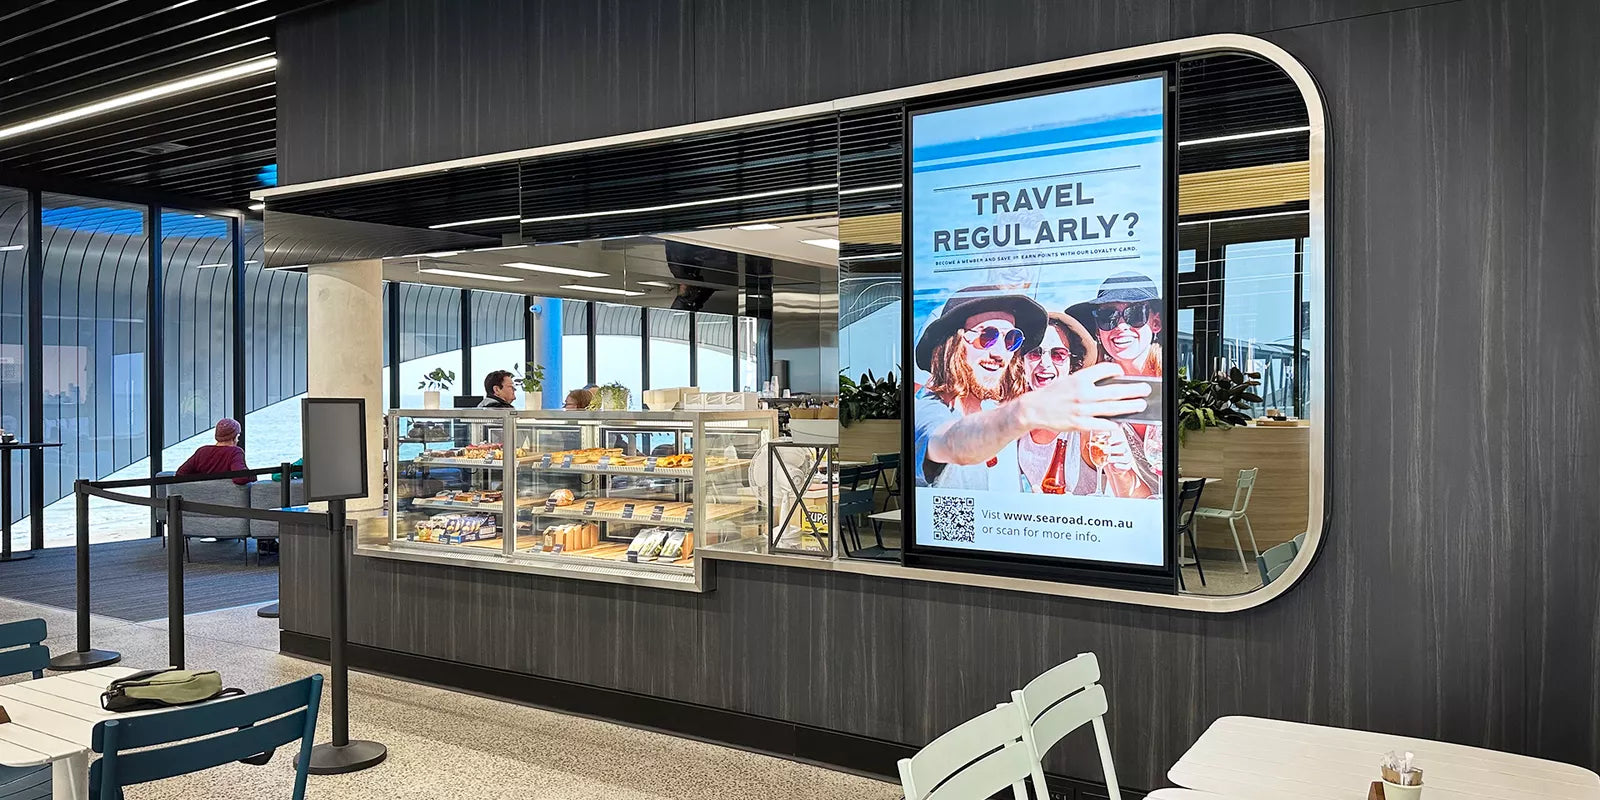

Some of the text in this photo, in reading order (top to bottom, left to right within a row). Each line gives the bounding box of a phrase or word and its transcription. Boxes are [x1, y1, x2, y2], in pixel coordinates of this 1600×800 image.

[971, 182, 1094, 215] TRAVEL
[934, 212, 1139, 252] REGULARLY?
[1090, 247, 1117, 255] LOYALTY
[981, 509, 1133, 529] Vist www.searoad.com.au
[982, 525, 1101, 543] or scan for more info.
